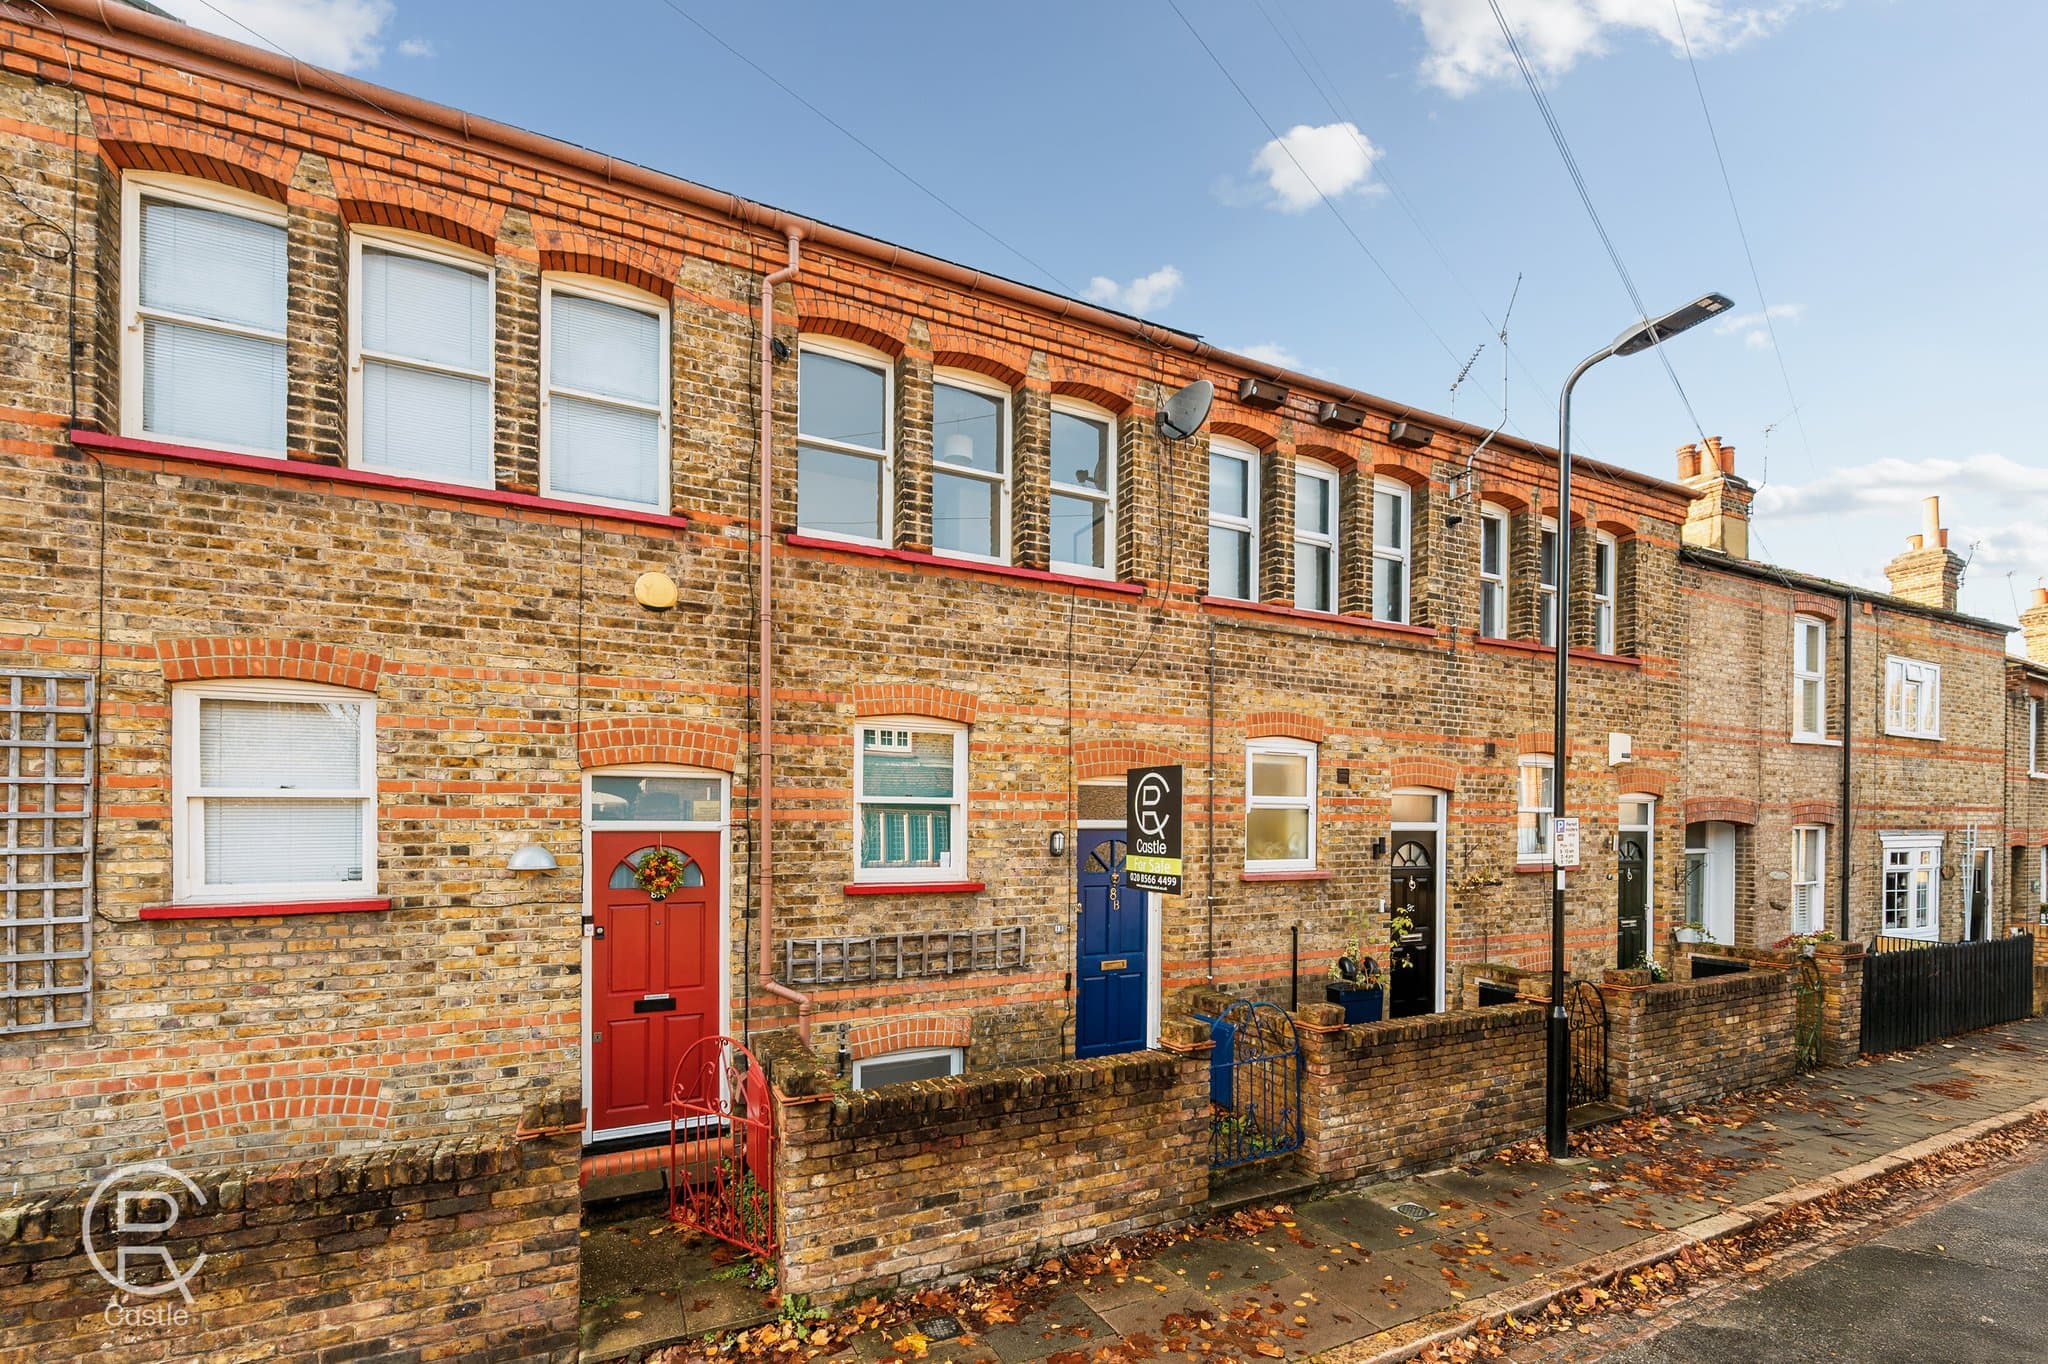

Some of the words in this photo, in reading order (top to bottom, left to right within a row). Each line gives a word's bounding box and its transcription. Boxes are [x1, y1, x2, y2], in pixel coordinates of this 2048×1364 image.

[1136, 838, 1167, 854] Castle
[1135, 857, 1146, 871] For
[1149, 859, 1171, 874] Sale
[1130, 872, 1140, 882] 020
[1140, 873, 1156, 885] 8566
[1157, 876, 1177, 886] 4499
